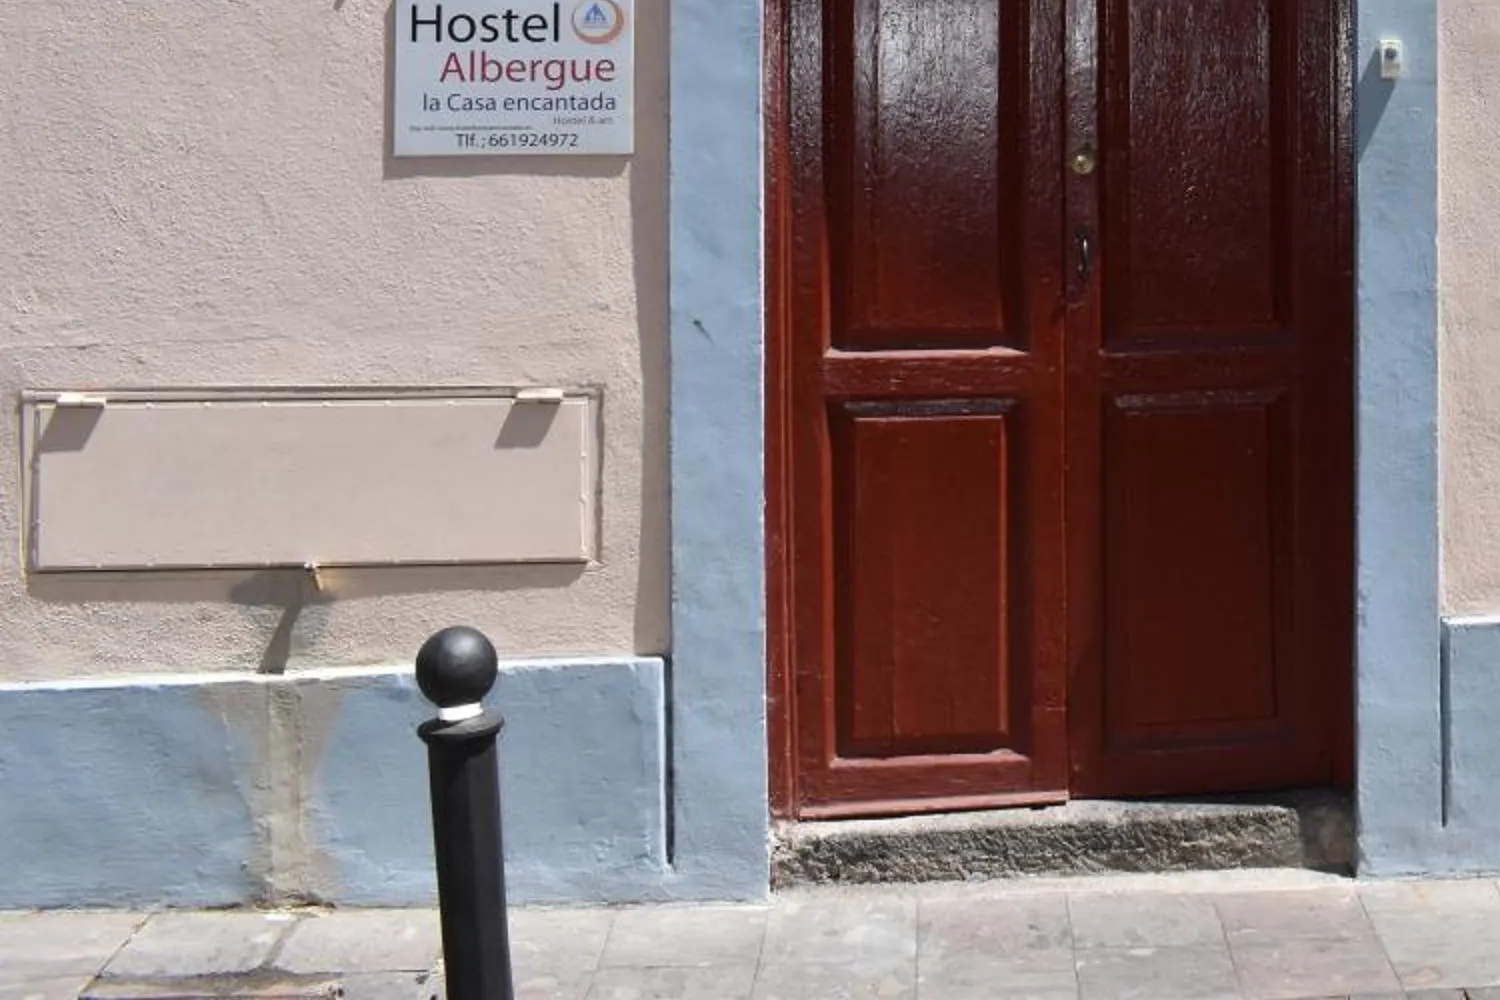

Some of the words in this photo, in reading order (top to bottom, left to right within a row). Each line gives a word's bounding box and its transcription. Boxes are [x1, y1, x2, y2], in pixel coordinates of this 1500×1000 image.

[410, 2, 560, 43] Hostel
[439, 50, 616, 91] Albergue
[422, 93, 441, 112] la
[447, 93, 497, 112] Casa
[503, 91, 616, 112] encantada
[488, 133, 579, 148] 661924972
